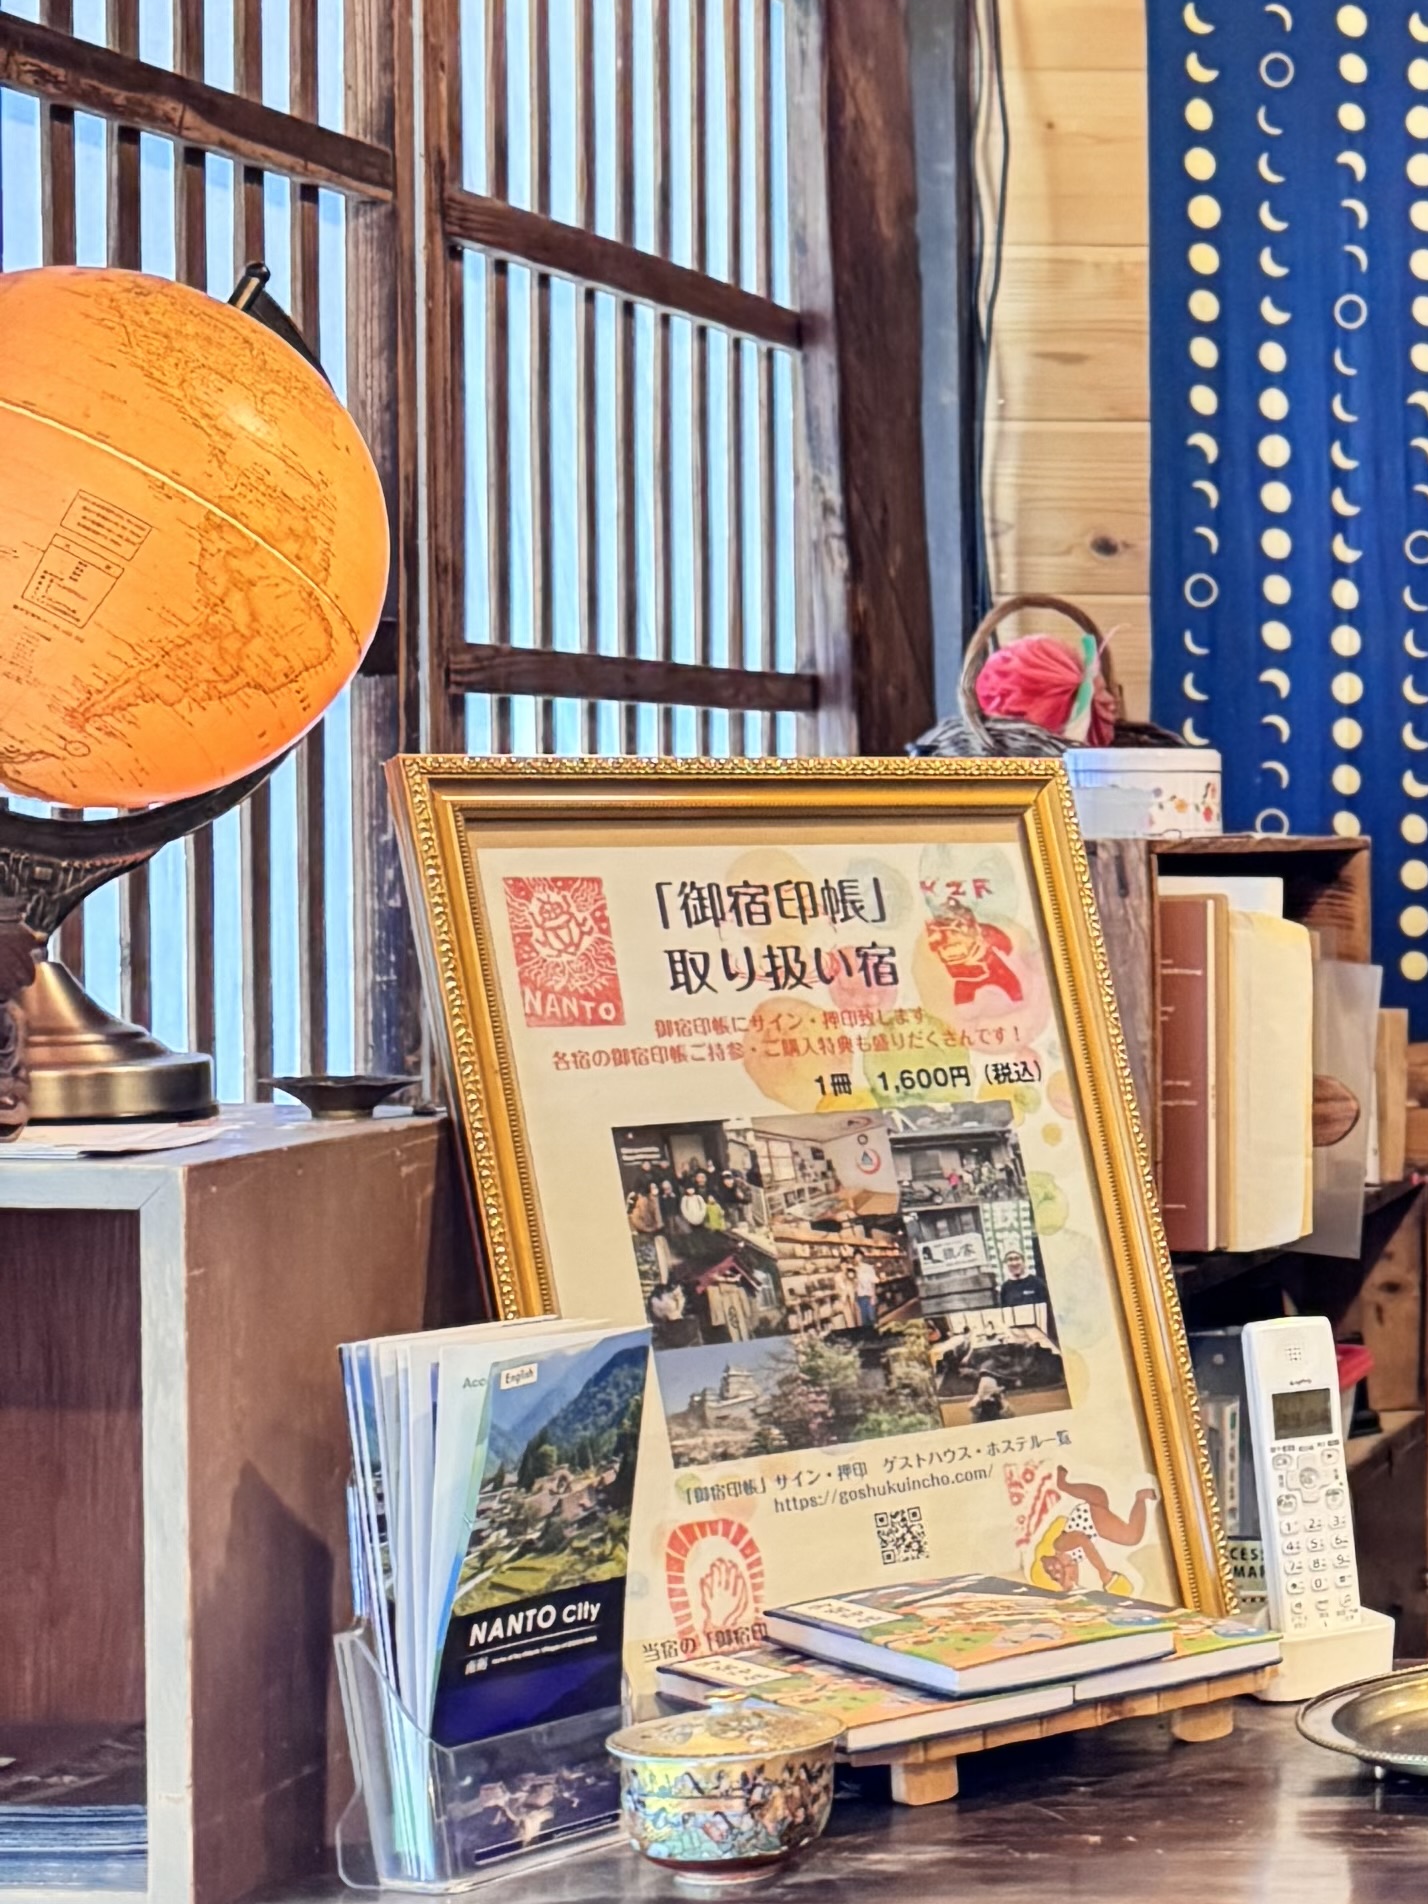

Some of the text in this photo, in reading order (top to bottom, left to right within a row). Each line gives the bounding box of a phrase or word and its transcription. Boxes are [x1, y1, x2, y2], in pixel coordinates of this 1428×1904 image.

[663, 941, 899, 994] 取り扱い宿
[523, 986, 616, 1021] NANTO
[655, 1006, 924, 1039] 御宿印帳にサイン・押印致します
[814, 1073, 852, 1097] 1冊
[773, 1465, 995, 1513] https://goshukuincho.com/
[469, 1605, 557, 1646] NANTO
